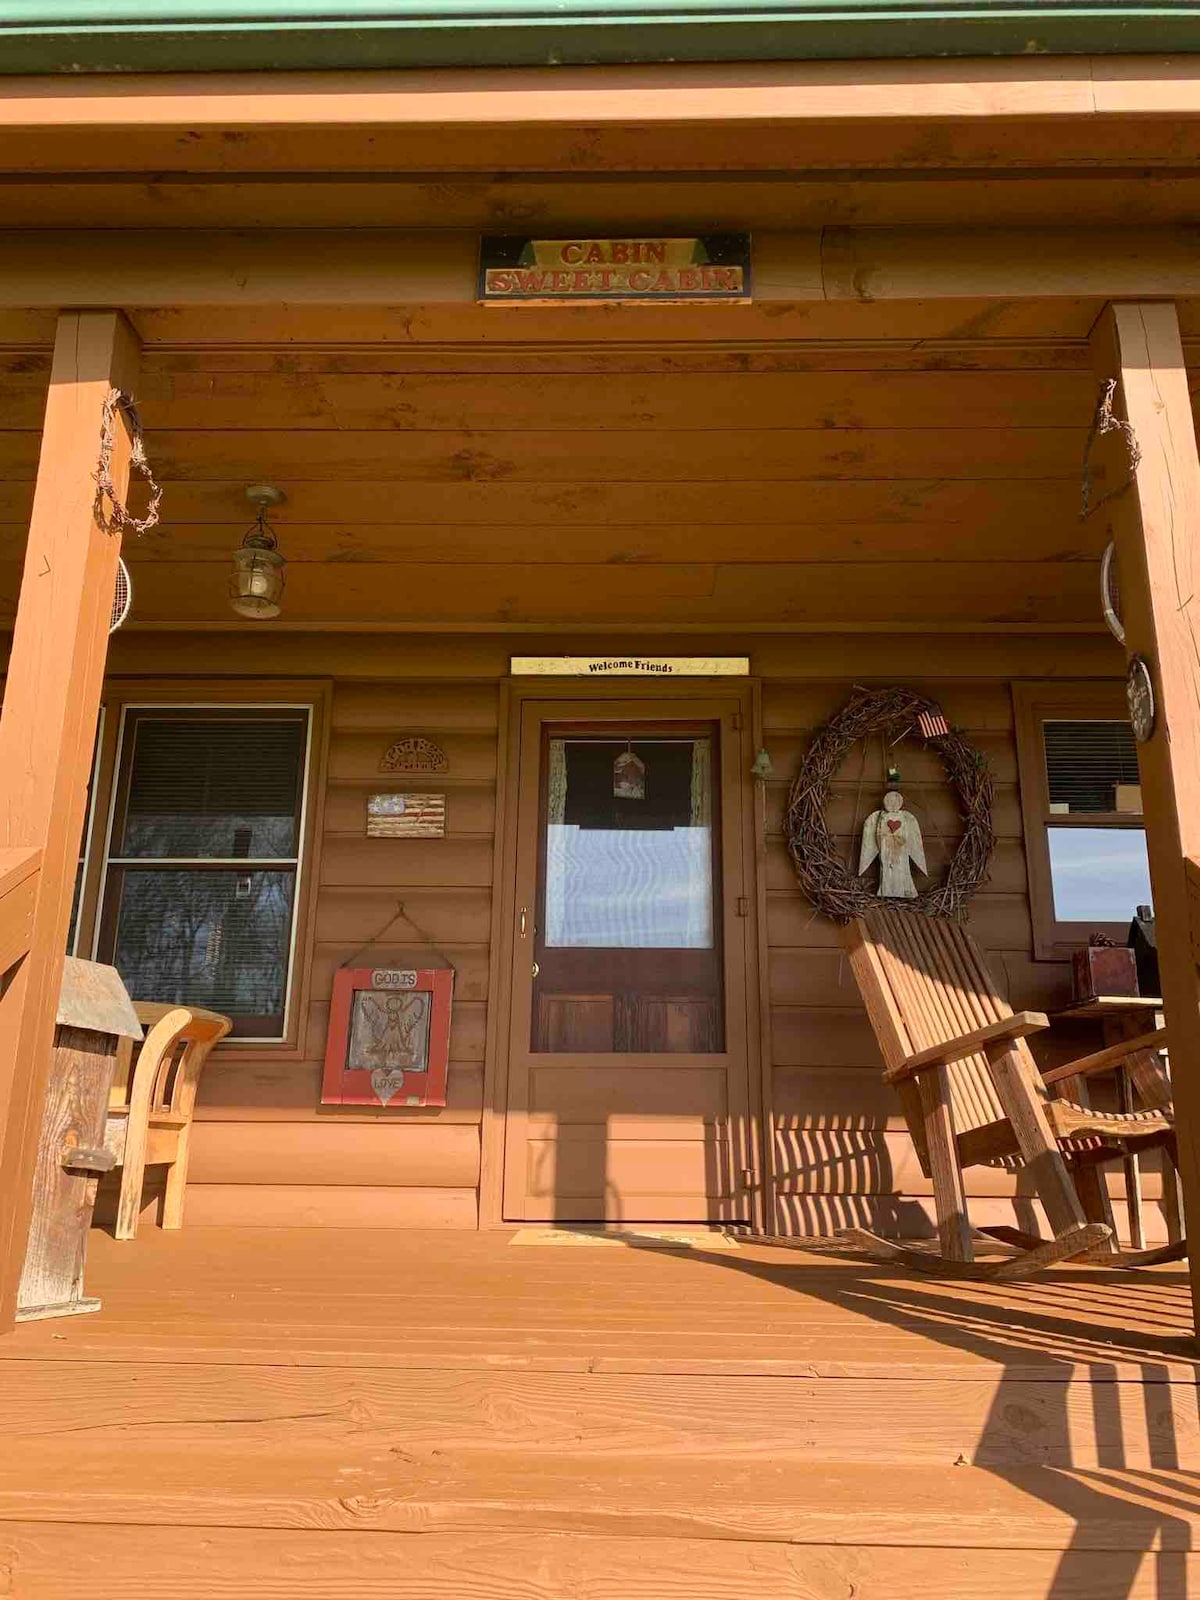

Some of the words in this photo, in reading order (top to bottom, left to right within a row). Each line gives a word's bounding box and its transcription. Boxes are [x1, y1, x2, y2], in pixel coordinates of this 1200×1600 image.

[560, 242, 666, 265] CABIN
[488, 269, 614, 291] SWEET
[629, 268, 738, 292] CABIN
[588, 661, 633, 673] Welcome
[634, 660, 673, 673] Friends
[374, 973, 399, 985] GOD
[373, 1077, 401, 1090] LOVE
